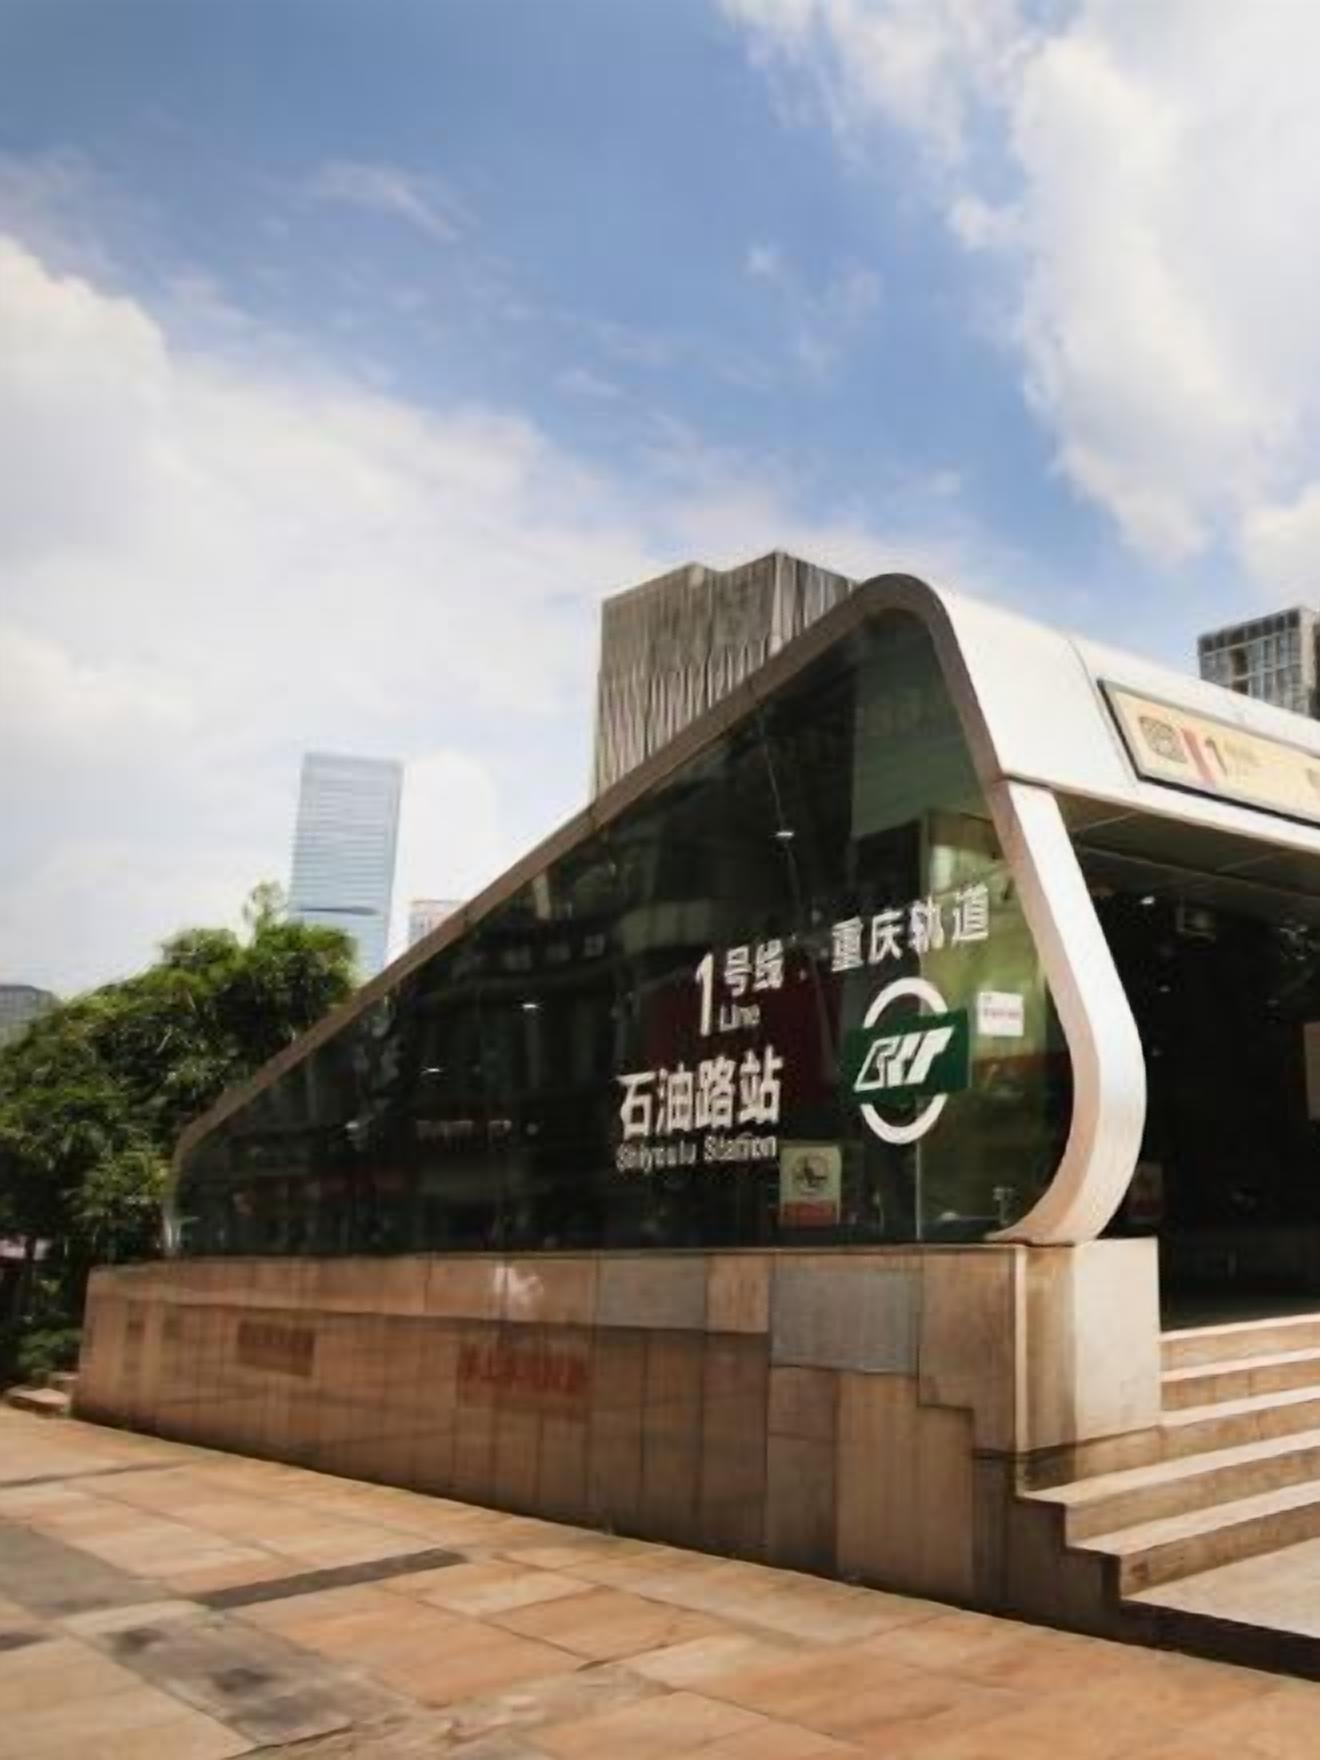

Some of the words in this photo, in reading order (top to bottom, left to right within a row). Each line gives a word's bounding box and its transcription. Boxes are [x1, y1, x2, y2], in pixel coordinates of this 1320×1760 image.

[831, 884, 989, 972] 重庆轨道
[616, 1044, 784, 1140] 石油路站
